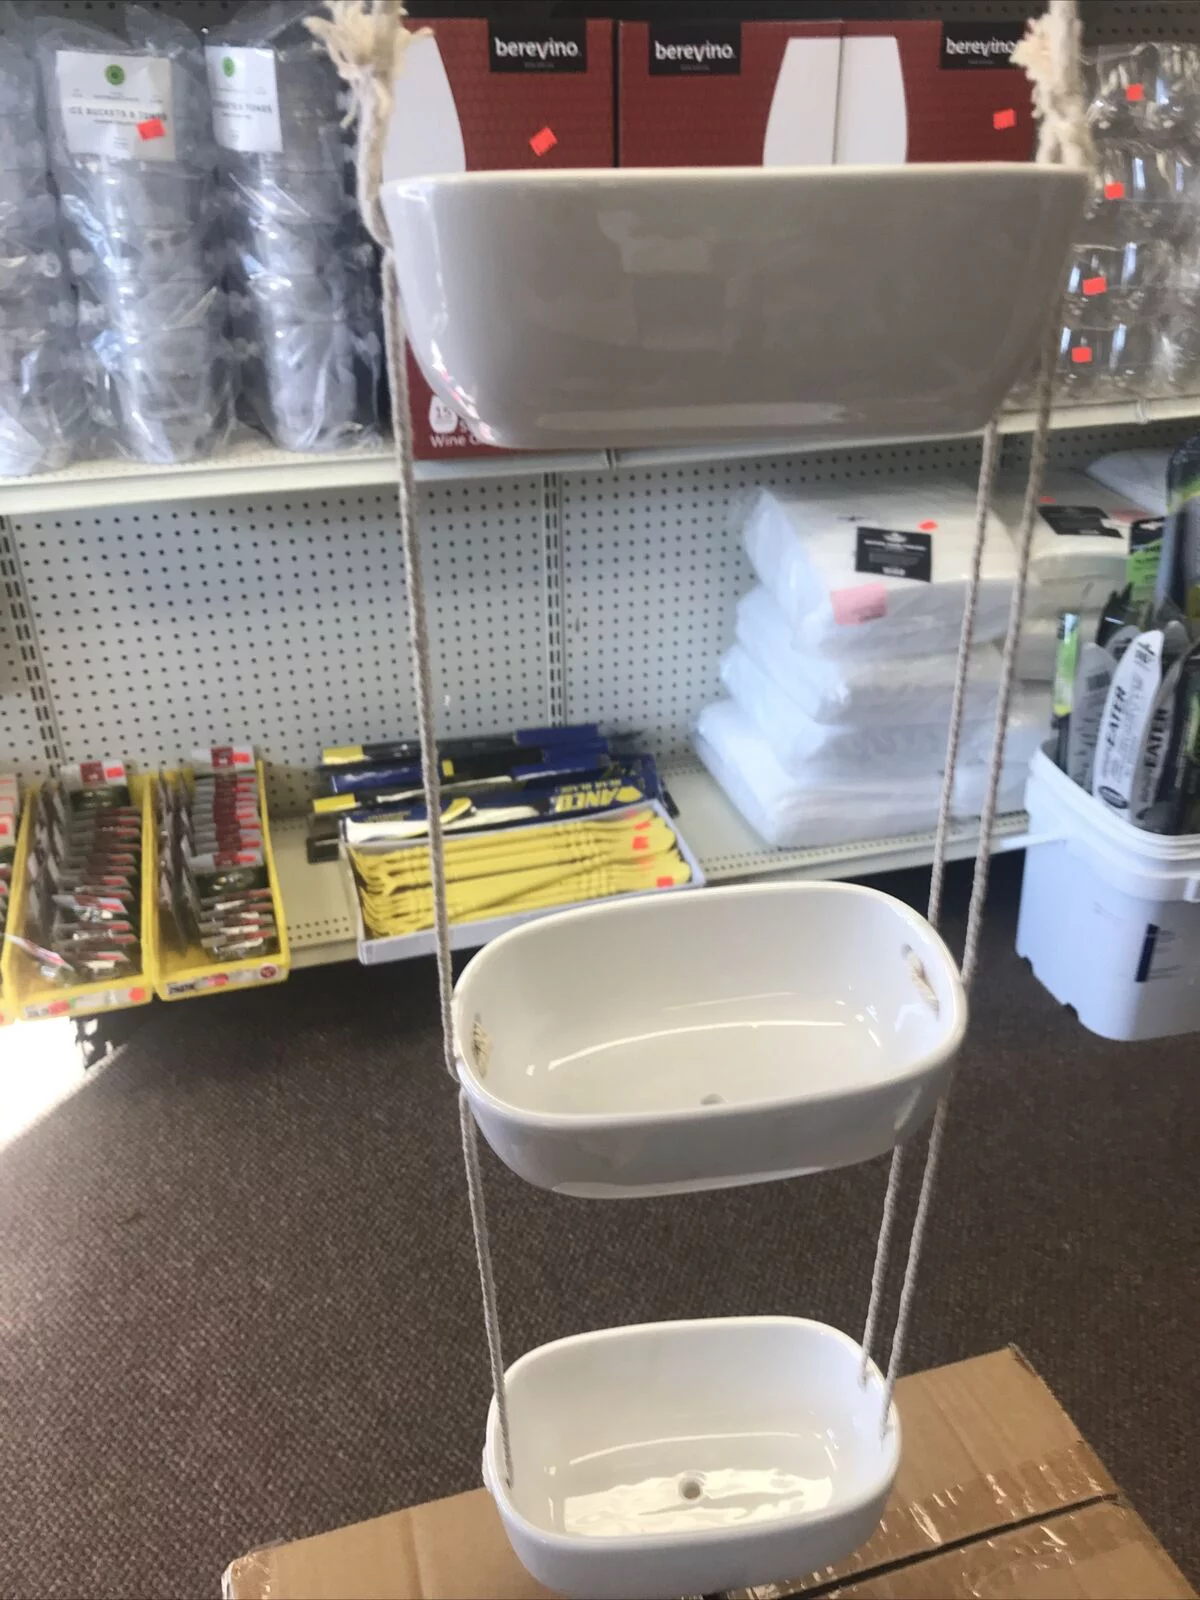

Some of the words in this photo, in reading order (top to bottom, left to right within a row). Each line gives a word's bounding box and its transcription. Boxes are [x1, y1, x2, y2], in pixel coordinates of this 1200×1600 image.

[495, 36, 578, 60] berevino
[655, 40, 733, 62] berevino
[430, 435, 466, 448] Wine
[555, 787, 620, 812] ANCO
